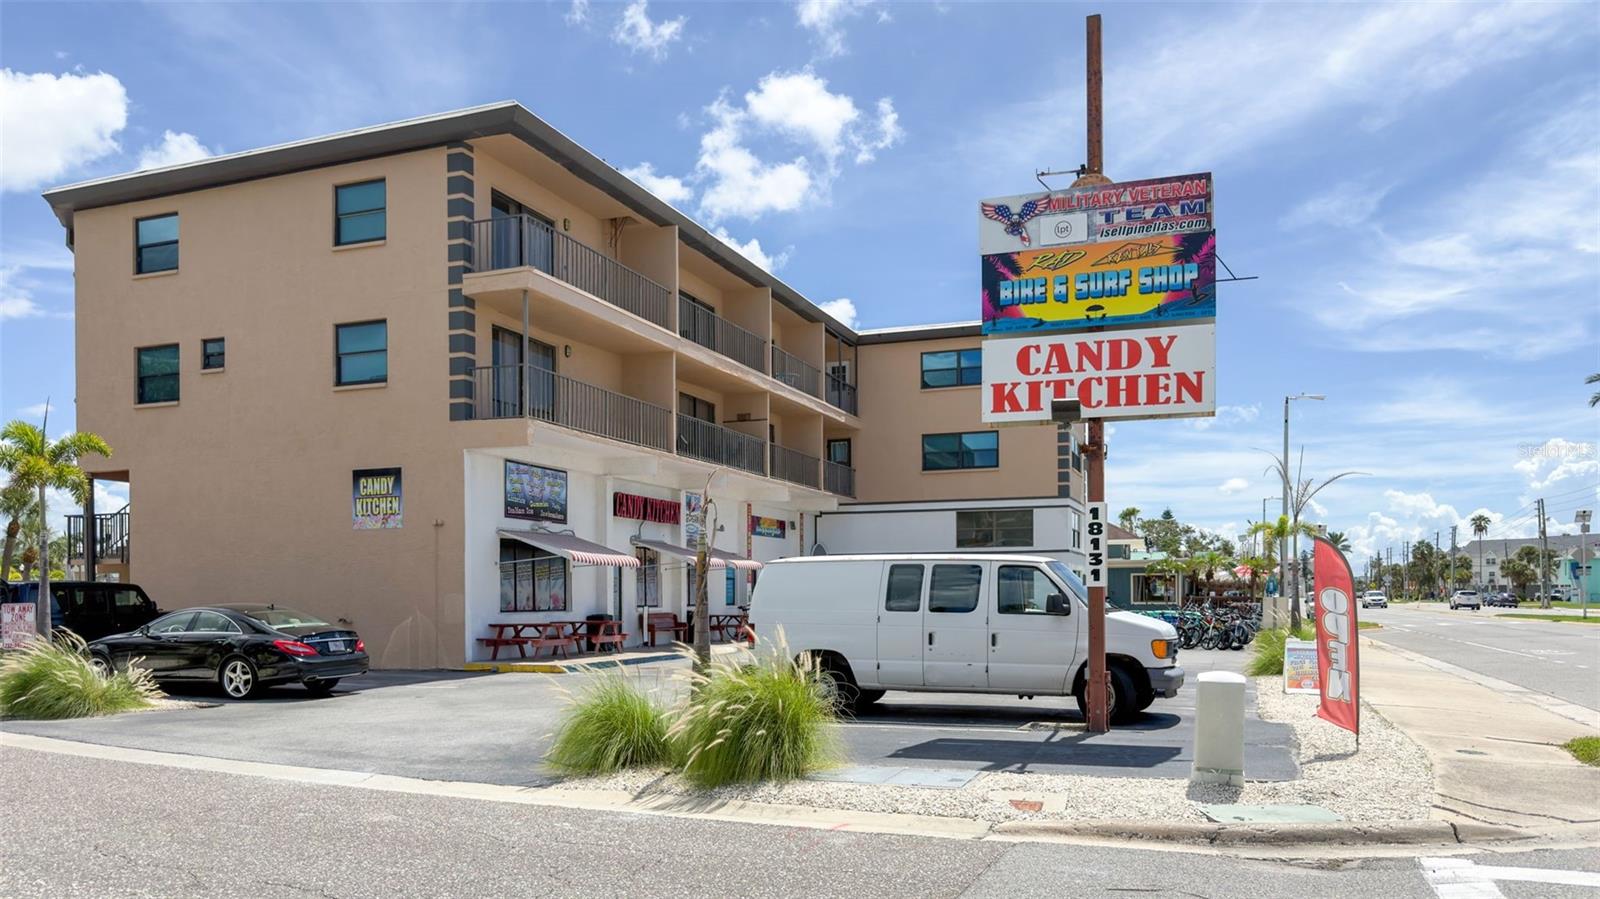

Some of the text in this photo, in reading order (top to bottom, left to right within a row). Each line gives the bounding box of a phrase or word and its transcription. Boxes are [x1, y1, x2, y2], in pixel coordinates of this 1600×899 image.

[1050, 179, 1207, 213] MILITARY VETERAN
[1100, 199, 1205, 224] TEAM
[1100, 217, 1206, 238] isellpinellas.com
[1027, 250, 1087, 272] RAD
[1000, 264, 1199, 307] BIKE & SURF SHOP
[1016, 335, 1178, 376] CANDY
[990, 371, 1205, 413] KITCHEN
[360, 476, 395, 496] CANDY
[355, 496, 400, 516] KITCHEN
[616, 492, 645, 520] CANDY
[646, 497, 681, 525] KITCHEN
[1088, 507, 1103, 581] 18131
[11, 613, 26, 622] ZONE
[18, 604, 33, 613] AWAY
